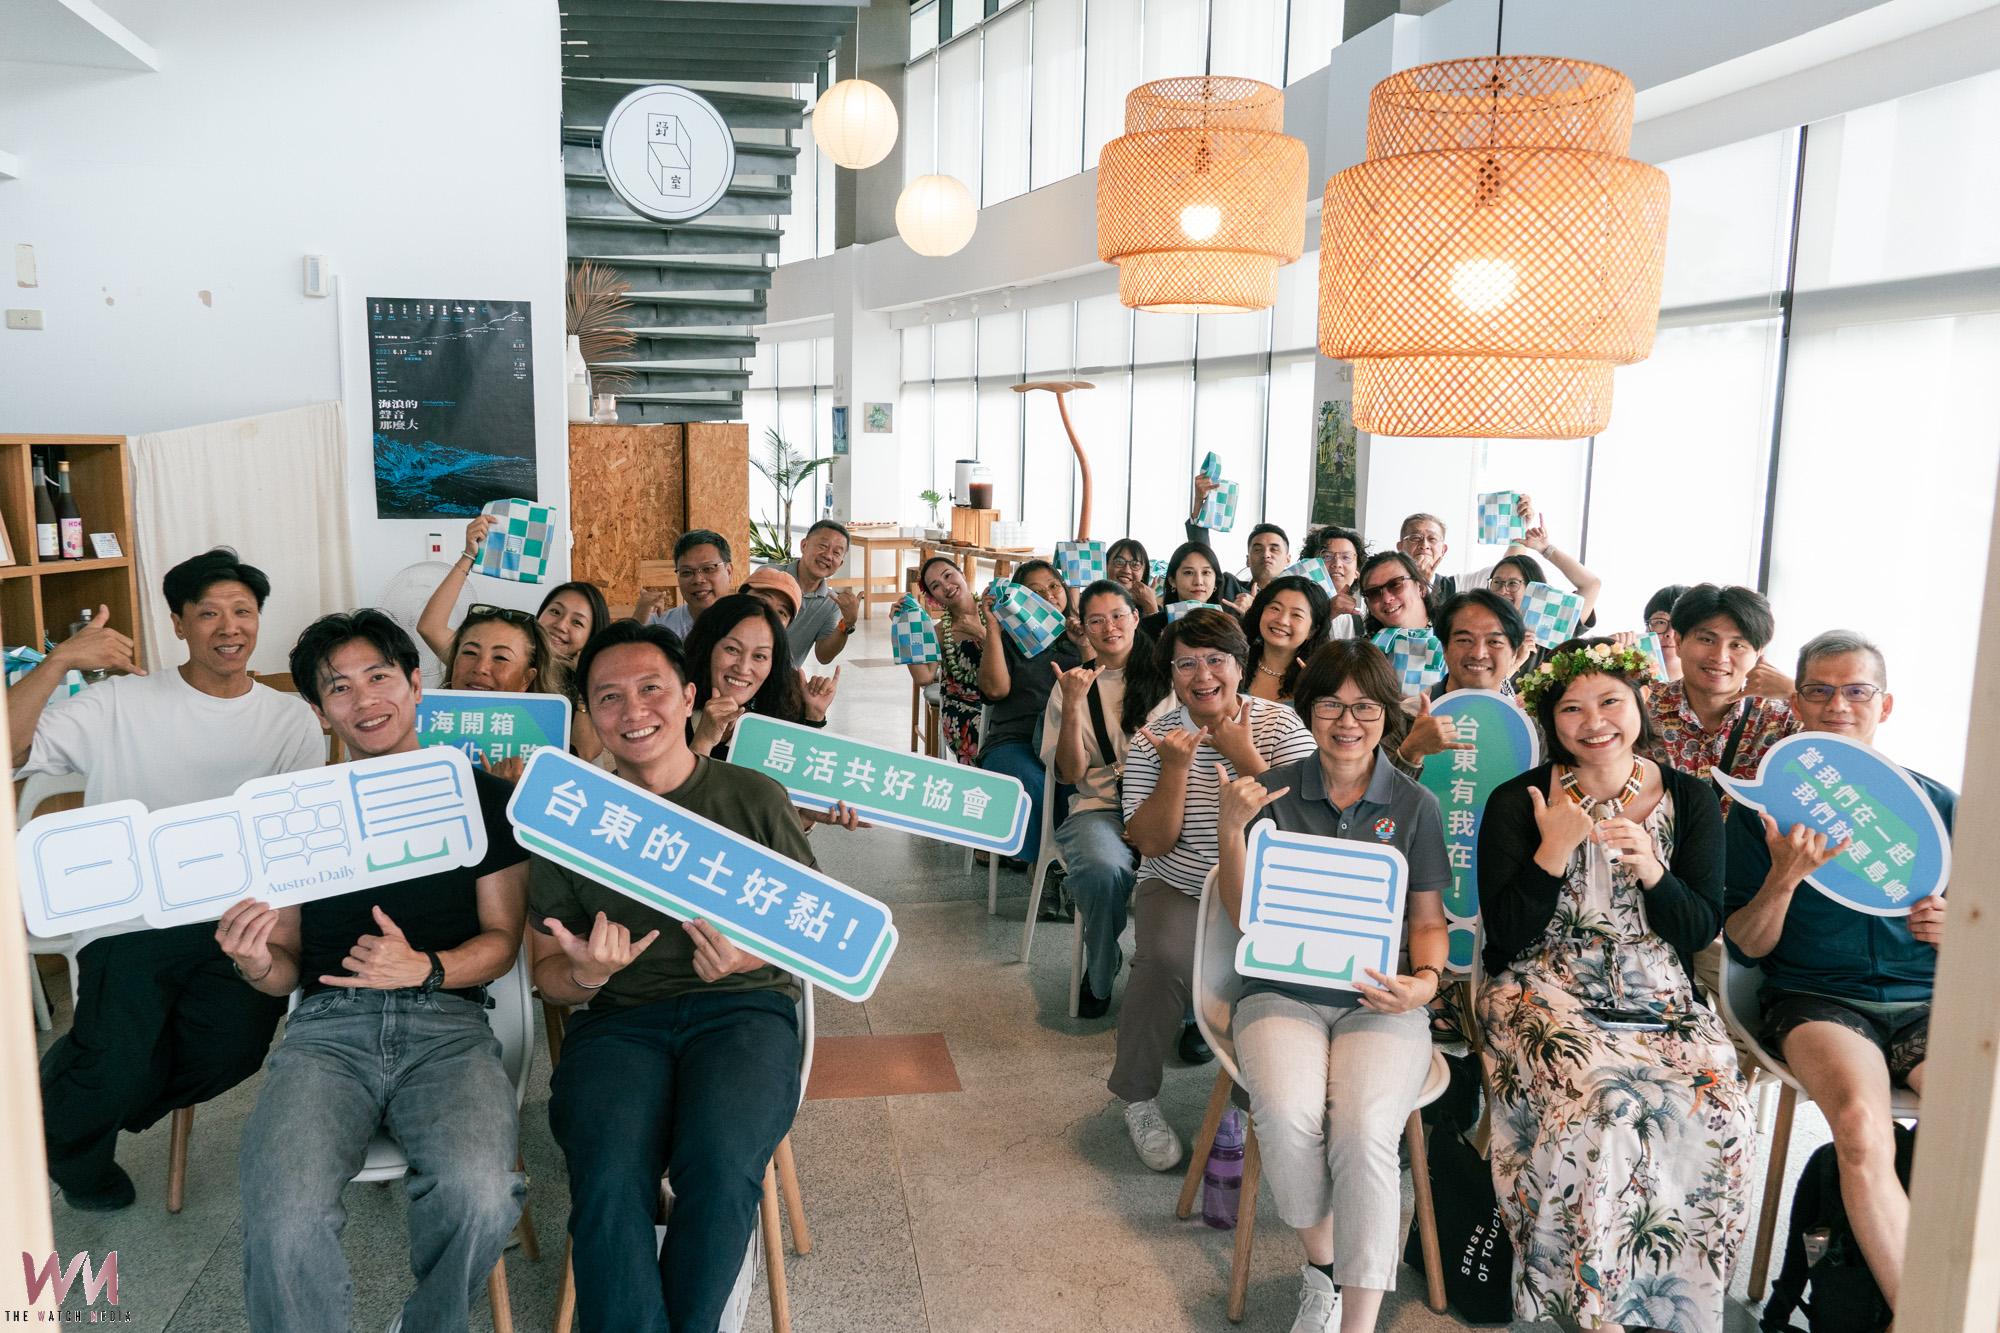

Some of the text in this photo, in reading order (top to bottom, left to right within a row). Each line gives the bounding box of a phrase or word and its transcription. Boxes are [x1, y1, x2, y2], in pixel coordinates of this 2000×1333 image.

[378, 400, 418, 409] 海浪的
[379, 410, 405, 419] 聲音
[380, 418, 419, 430] 那麼大
[763, 738, 993, 820] 島活共好協會
[1797, 747, 1916, 866] 當我們在一起
[544, 779, 859, 952] 台東的土好黏！
[1792, 782, 1910, 903] 我們就是島嶼
[267, 866, 357, 894] Austro Daily
[1461, 1225, 1485, 1276] SENSE
[1478, 1207, 1501, 1282] OF TOUCH
